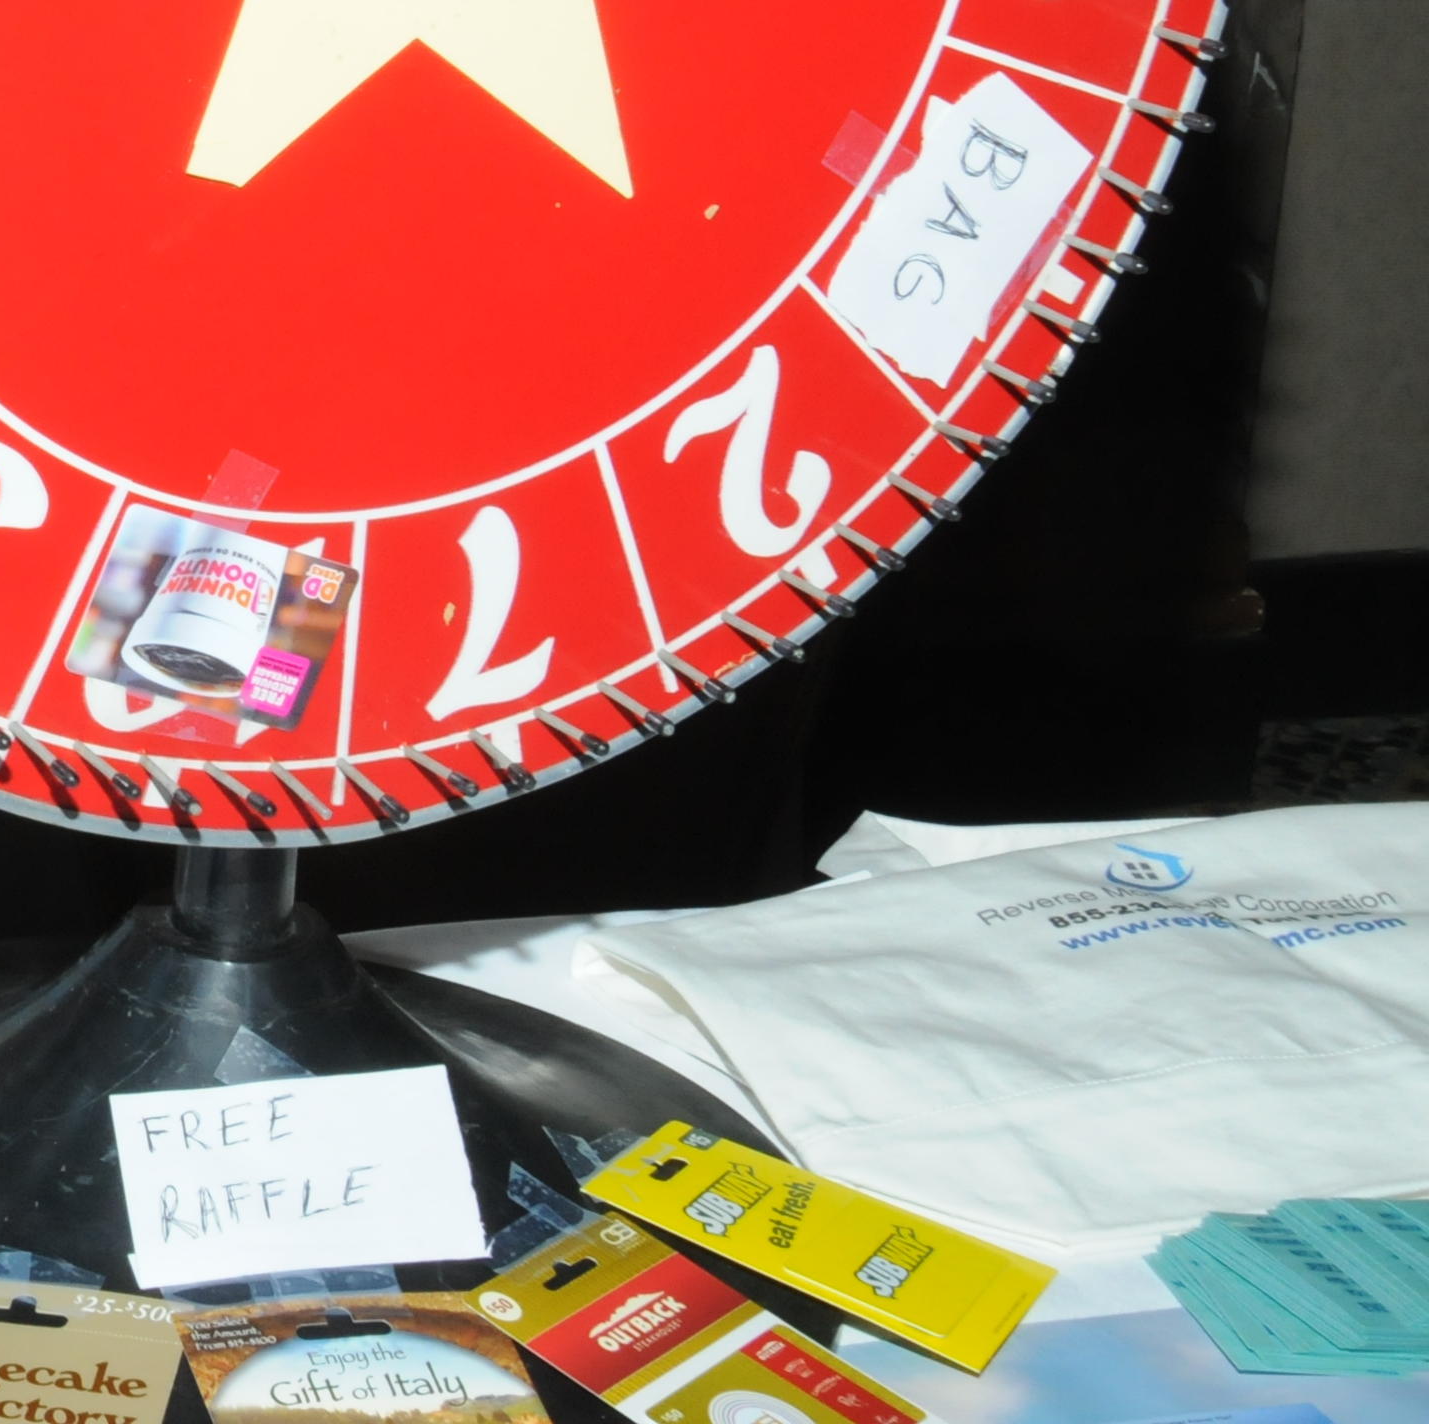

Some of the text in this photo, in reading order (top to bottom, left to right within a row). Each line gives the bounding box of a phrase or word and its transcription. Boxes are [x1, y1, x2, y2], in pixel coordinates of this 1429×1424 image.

[892, 118, 1027, 306] BAG
[664, 344, 832, 558] 2
[172, 557, 258, 589] DONUTS
[425, 505, 555, 722] 7
[976, 888, 1097, 927] Reverse
[1239, 888, 1397, 913] Corporation
[139, 1092, 296, 1153] FREE
[159, 1164, 381, 1243] RAFFLE
[684, 1161, 773, 1237] SUBWAY
[768, 1181, 816, 1249] eat fresh.
[855, 1225, 934, 1300] SUBWAY
[487, 1297, 514, 1315] $50
[596, 1295, 687, 1353] OUTBACK
[269, 1361, 469, 1407] Gift of Italy
[306, 1342, 406, 1375] Enjoy the
